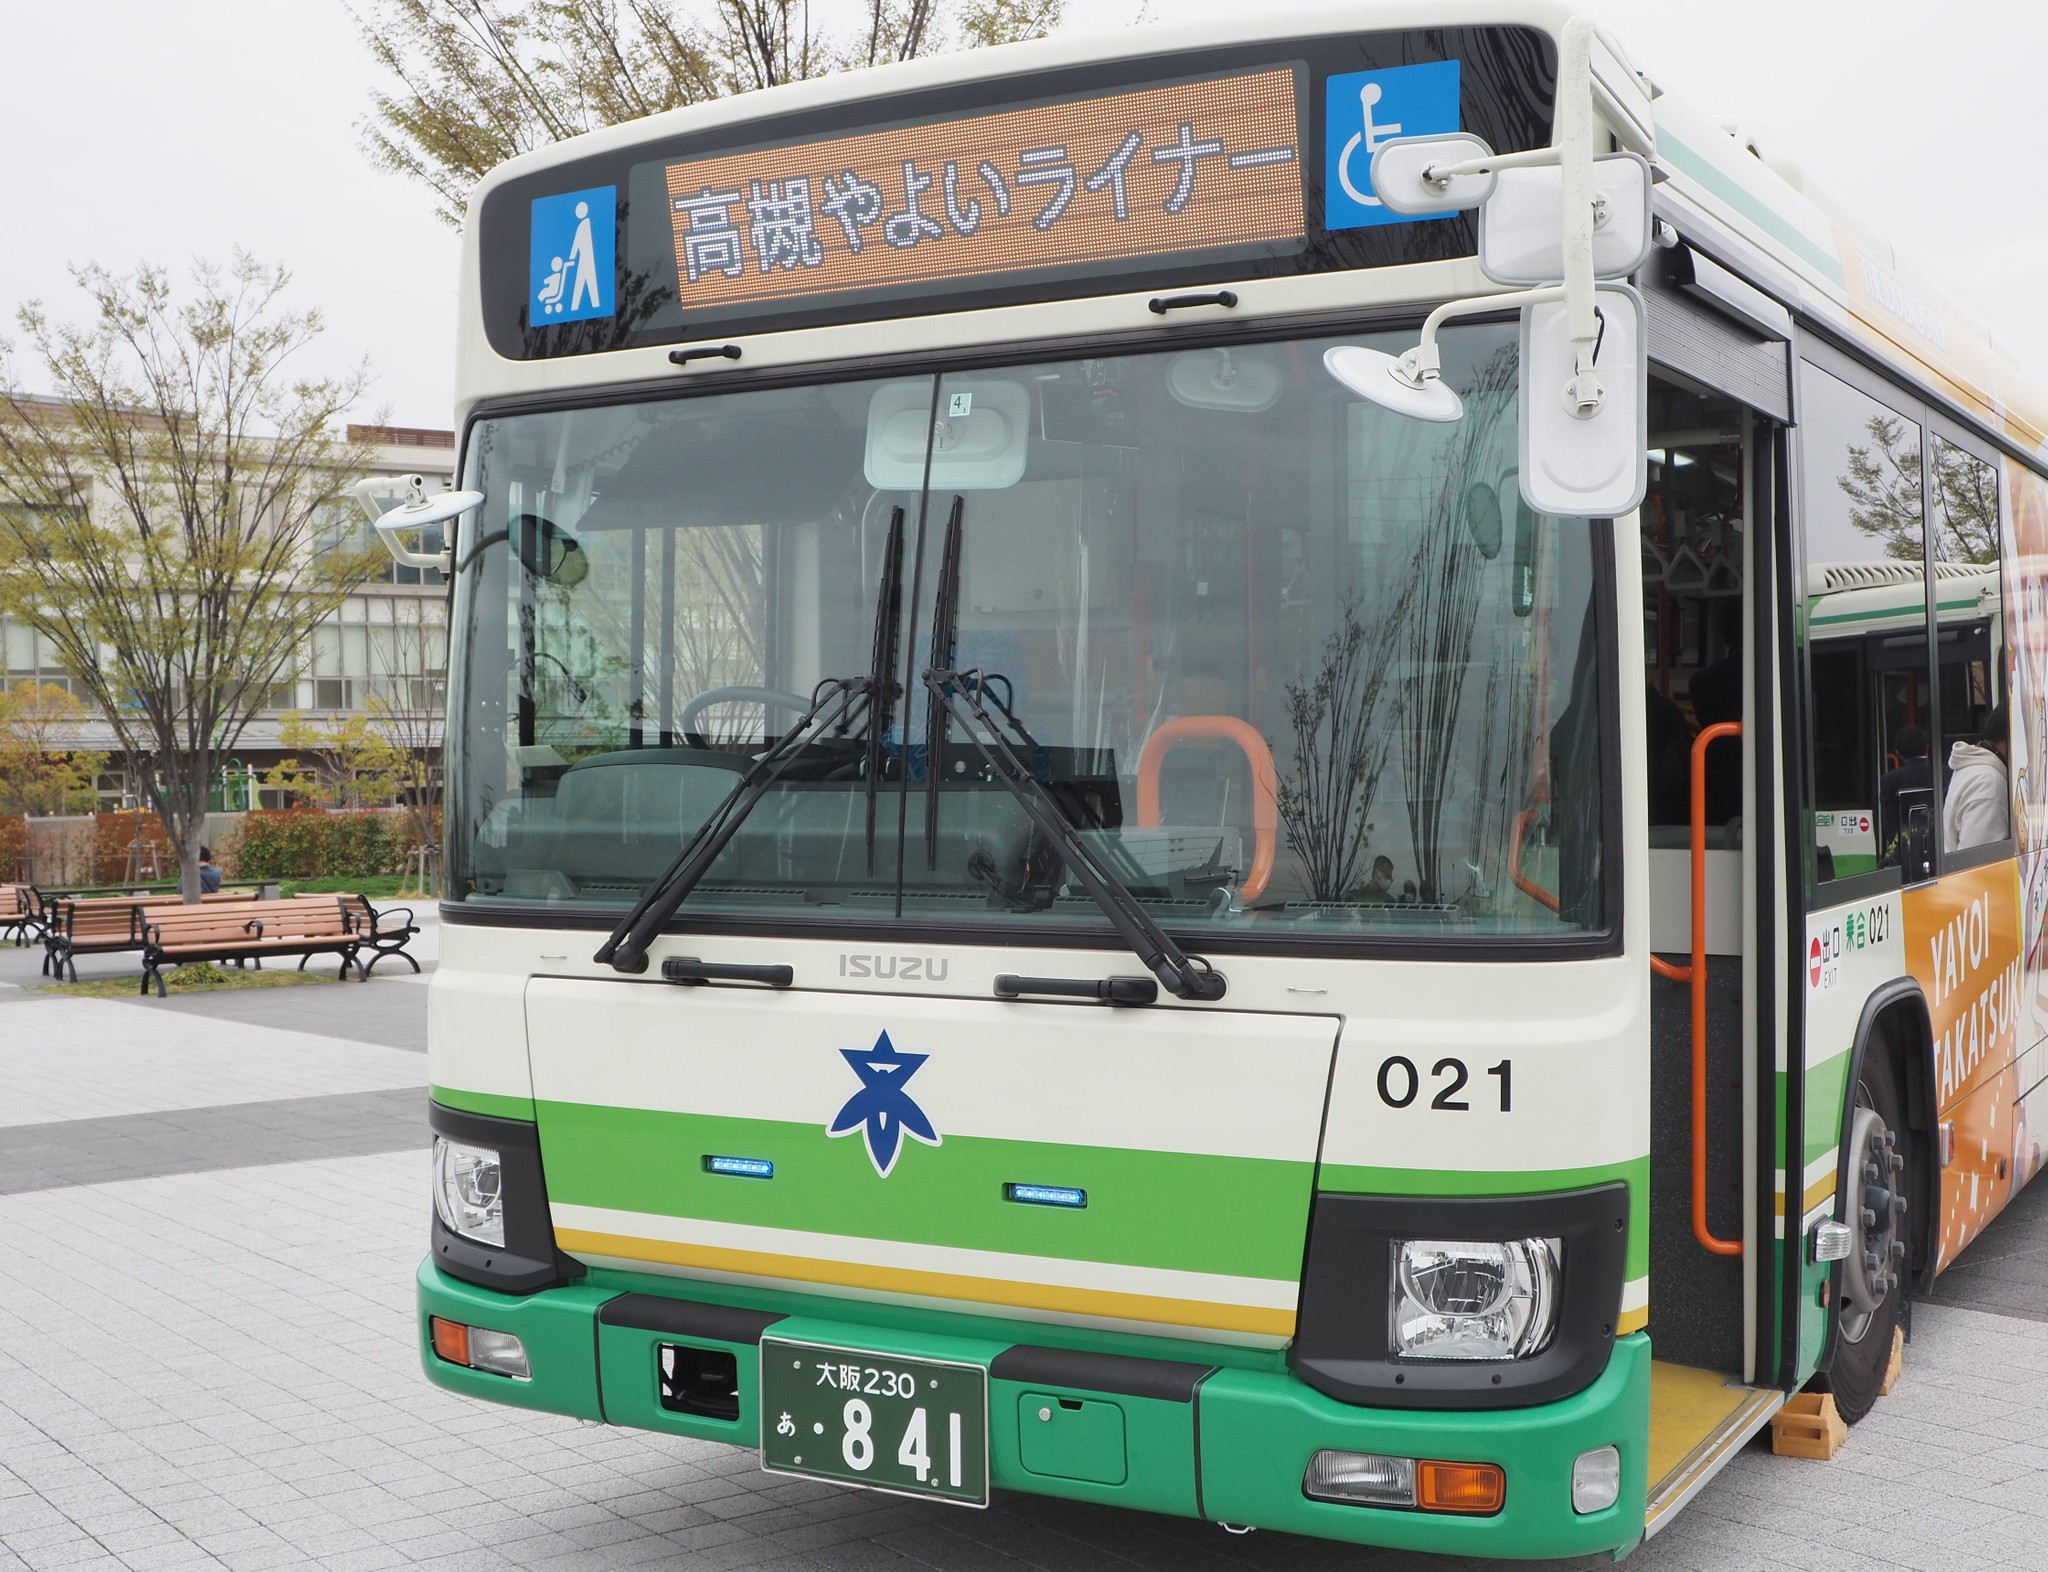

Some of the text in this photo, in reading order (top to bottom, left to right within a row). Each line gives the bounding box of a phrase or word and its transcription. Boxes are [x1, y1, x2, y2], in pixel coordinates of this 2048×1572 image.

[674, 124, 1294, 281] 高槻やよいライナー
[954, 395, 962, 408] 4
[1822, 927, 1839, 963] 出口
[1846, 903, 1889, 952] 乗合 021
[839, 954, 949, 982] ISUZU
[1930, 890, 1990, 1008] YAYOI
[1824, 967, 1837, 989] EXIT
[1376, 1055, 1512, 1113] 021
